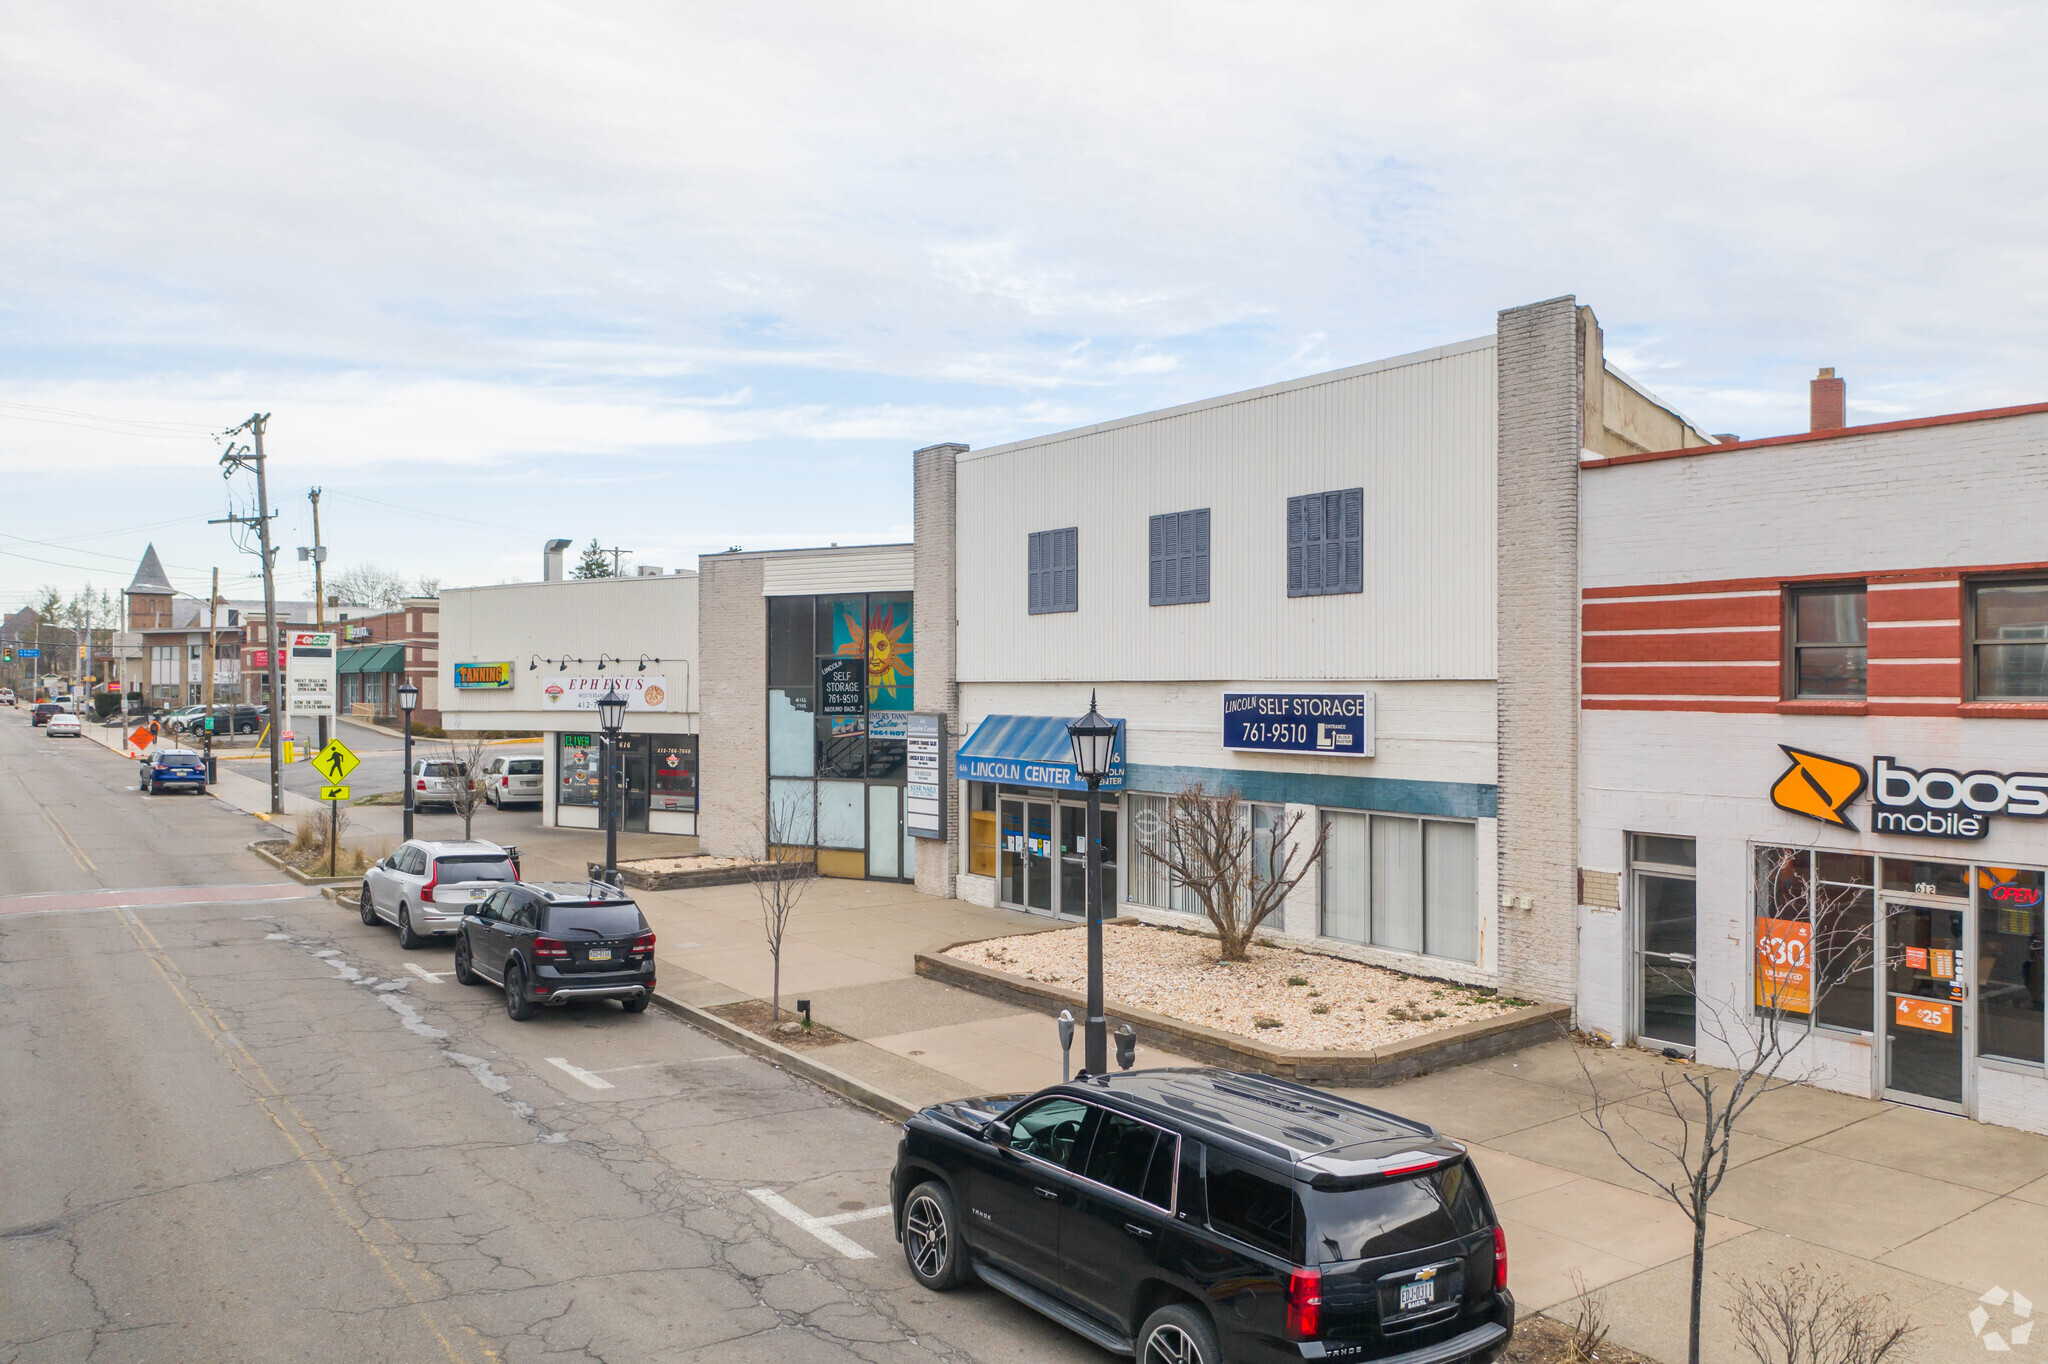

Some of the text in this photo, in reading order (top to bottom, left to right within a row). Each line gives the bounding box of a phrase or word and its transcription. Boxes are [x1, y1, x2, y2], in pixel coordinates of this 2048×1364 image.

[460, 666, 503, 683] TANNING
[821, 660, 843, 675] LINCOLN
[833, 671, 851, 682] SELF
[569, 678, 644, 690] EPHESUS
[826, 682, 859, 692] STORAGE
[828, 694, 859, 704] 761-9510
[1225, 695, 1363, 717] LINCOLN SELF STORAGE
[824, 705, 843, 713] AROUND
[1242, 722, 1307, 743] 761-9510
[959, 764, 968, 772] 616
[971, 762, 1020, 780] LINCOLN
[1025, 765, 1070, 784] CENTER
[1877, 811, 1980, 836] mobile
[1916, 885, 1935, 895] 612
[1993, 886, 2039, 904] OPEN
[1759, 936, 1805, 967] $30
[1898, 1000, 1909, 1014] 4
[1917, 1009, 1942, 1027] $25
[971, 1207, 992, 1221] TAHOE
[1326, 1346, 1362, 1358] TAHOE
